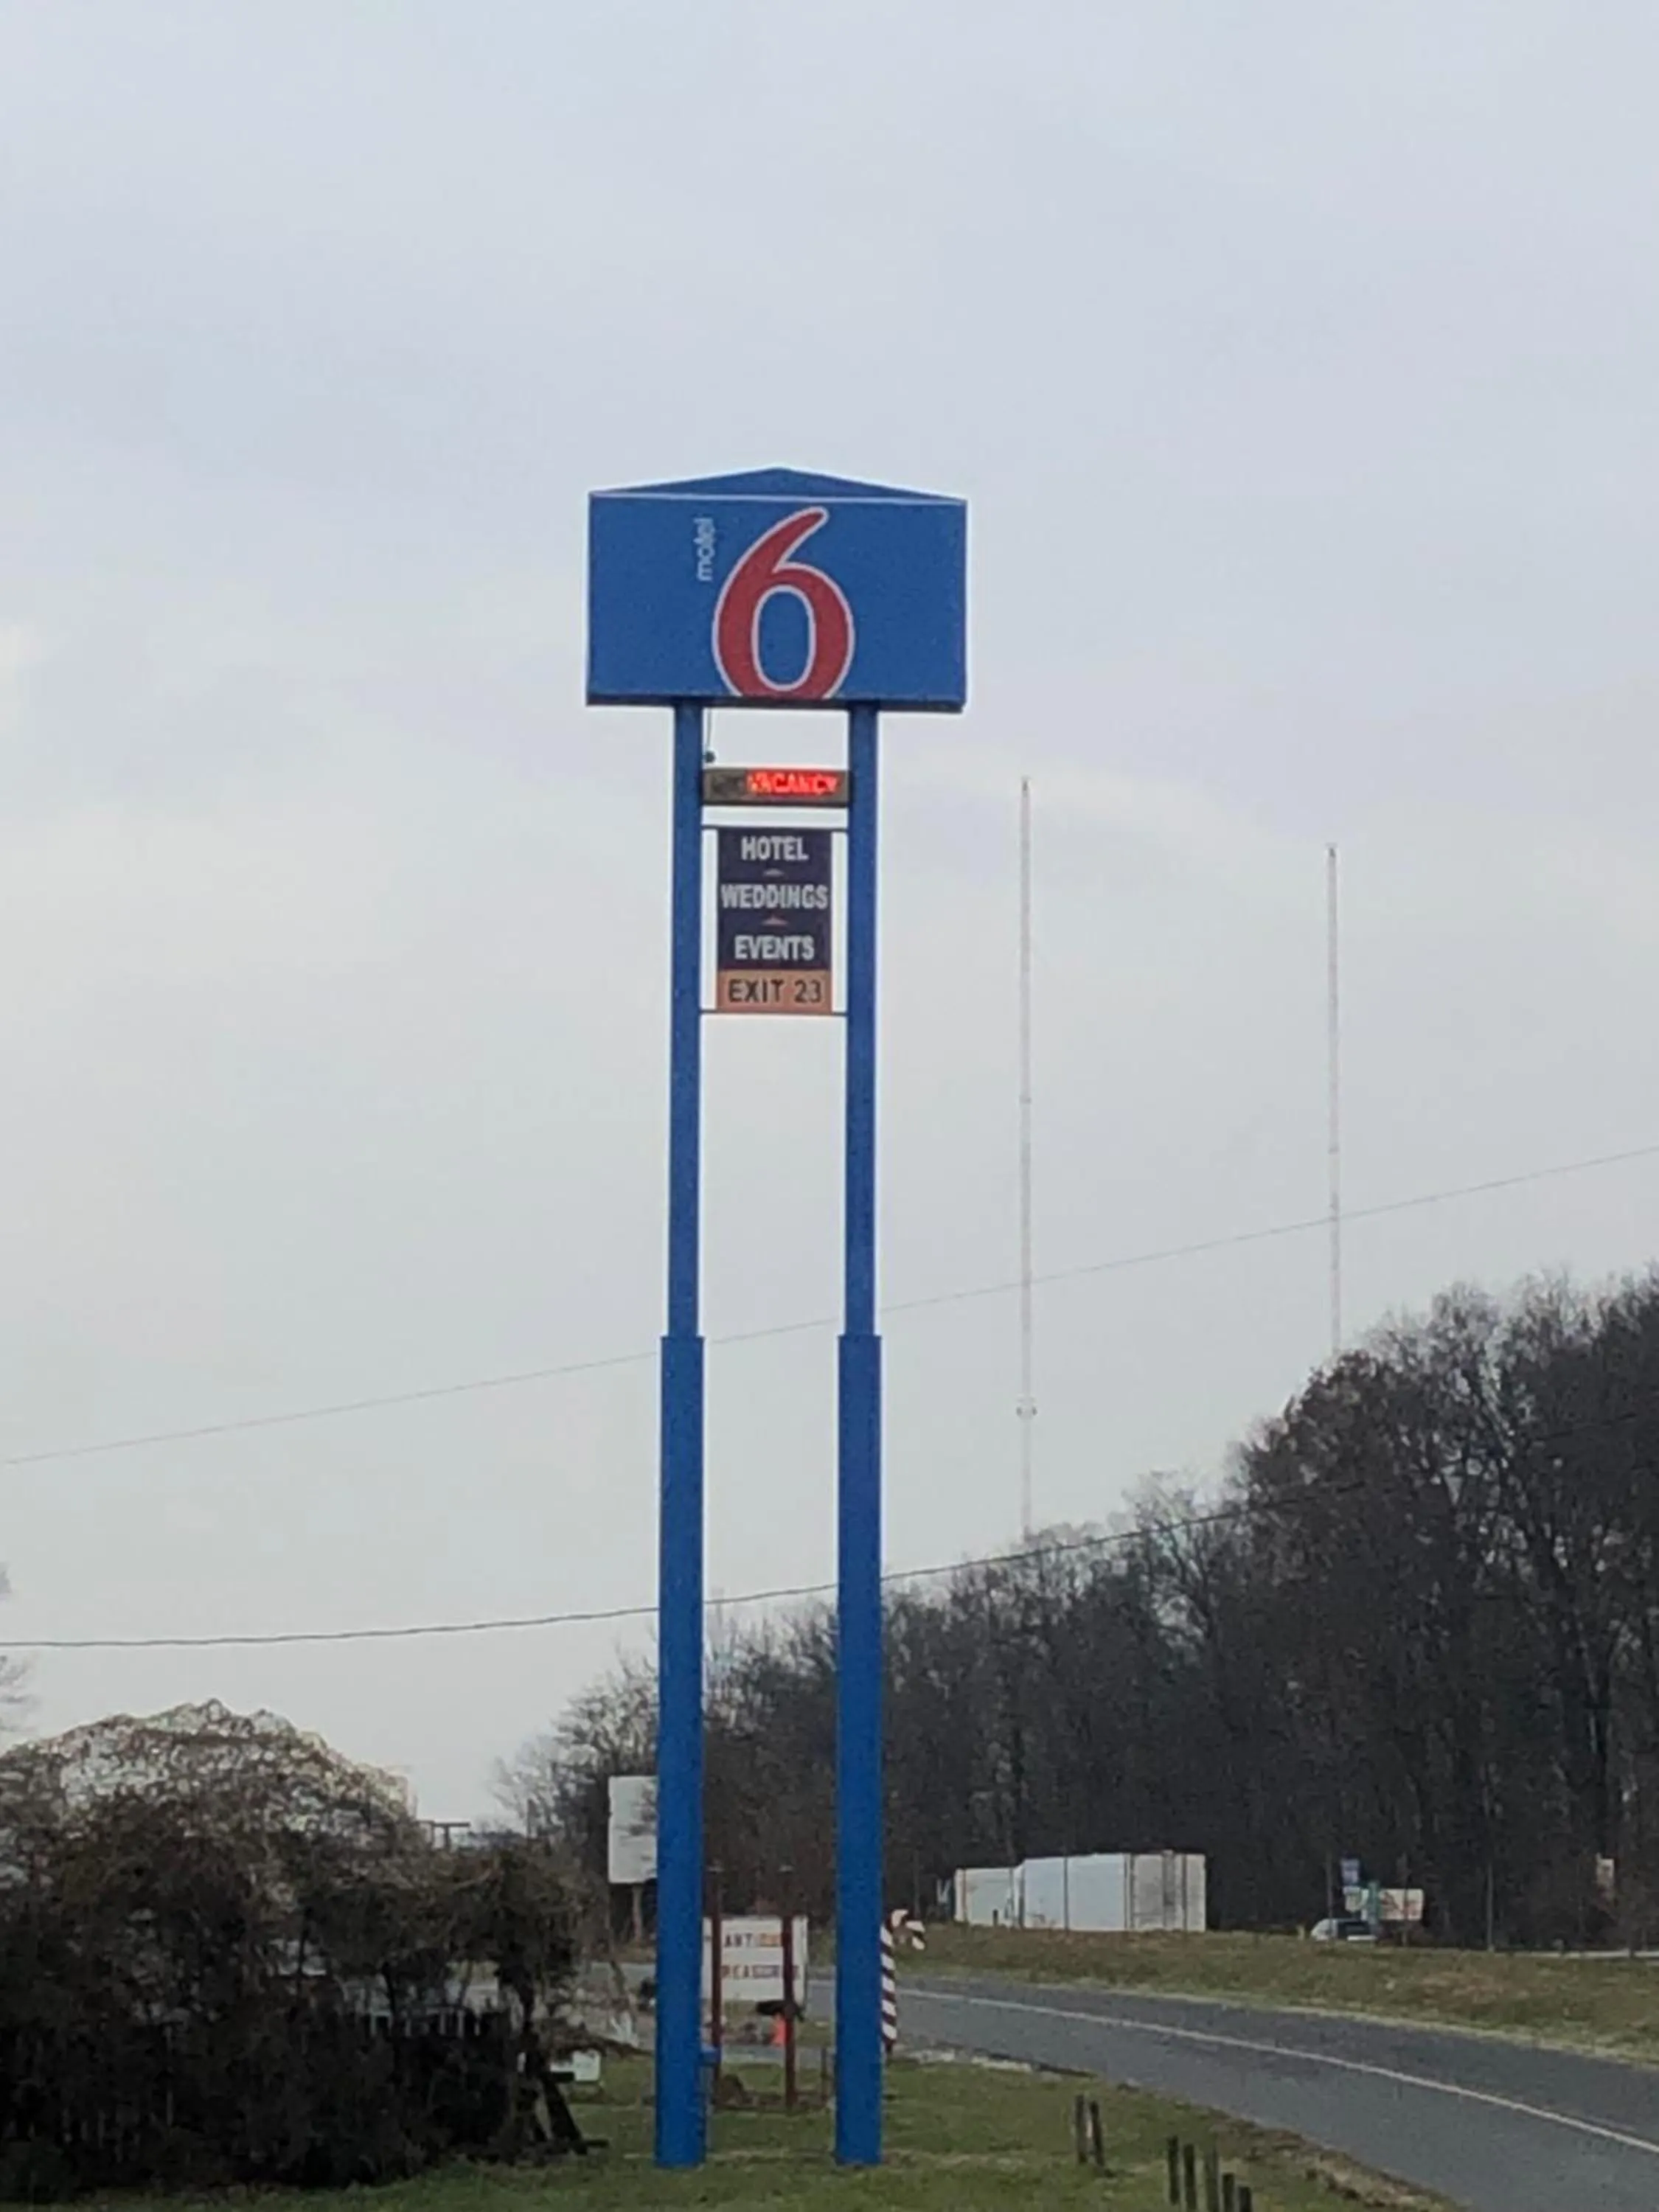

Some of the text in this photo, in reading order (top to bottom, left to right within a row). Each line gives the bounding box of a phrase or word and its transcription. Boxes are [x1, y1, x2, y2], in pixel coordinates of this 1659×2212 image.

[693, 518, 714, 581] motel
[712, 507, 855, 699] 6
[747, 771, 838, 794] VACANCY
[740, 835, 809, 861] HOTEL
[720, 884, 829, 909] WEDDINGS
[734, 934, 815, 961] EVENTS
[728, 978, 821, 1003] EXIT 23
